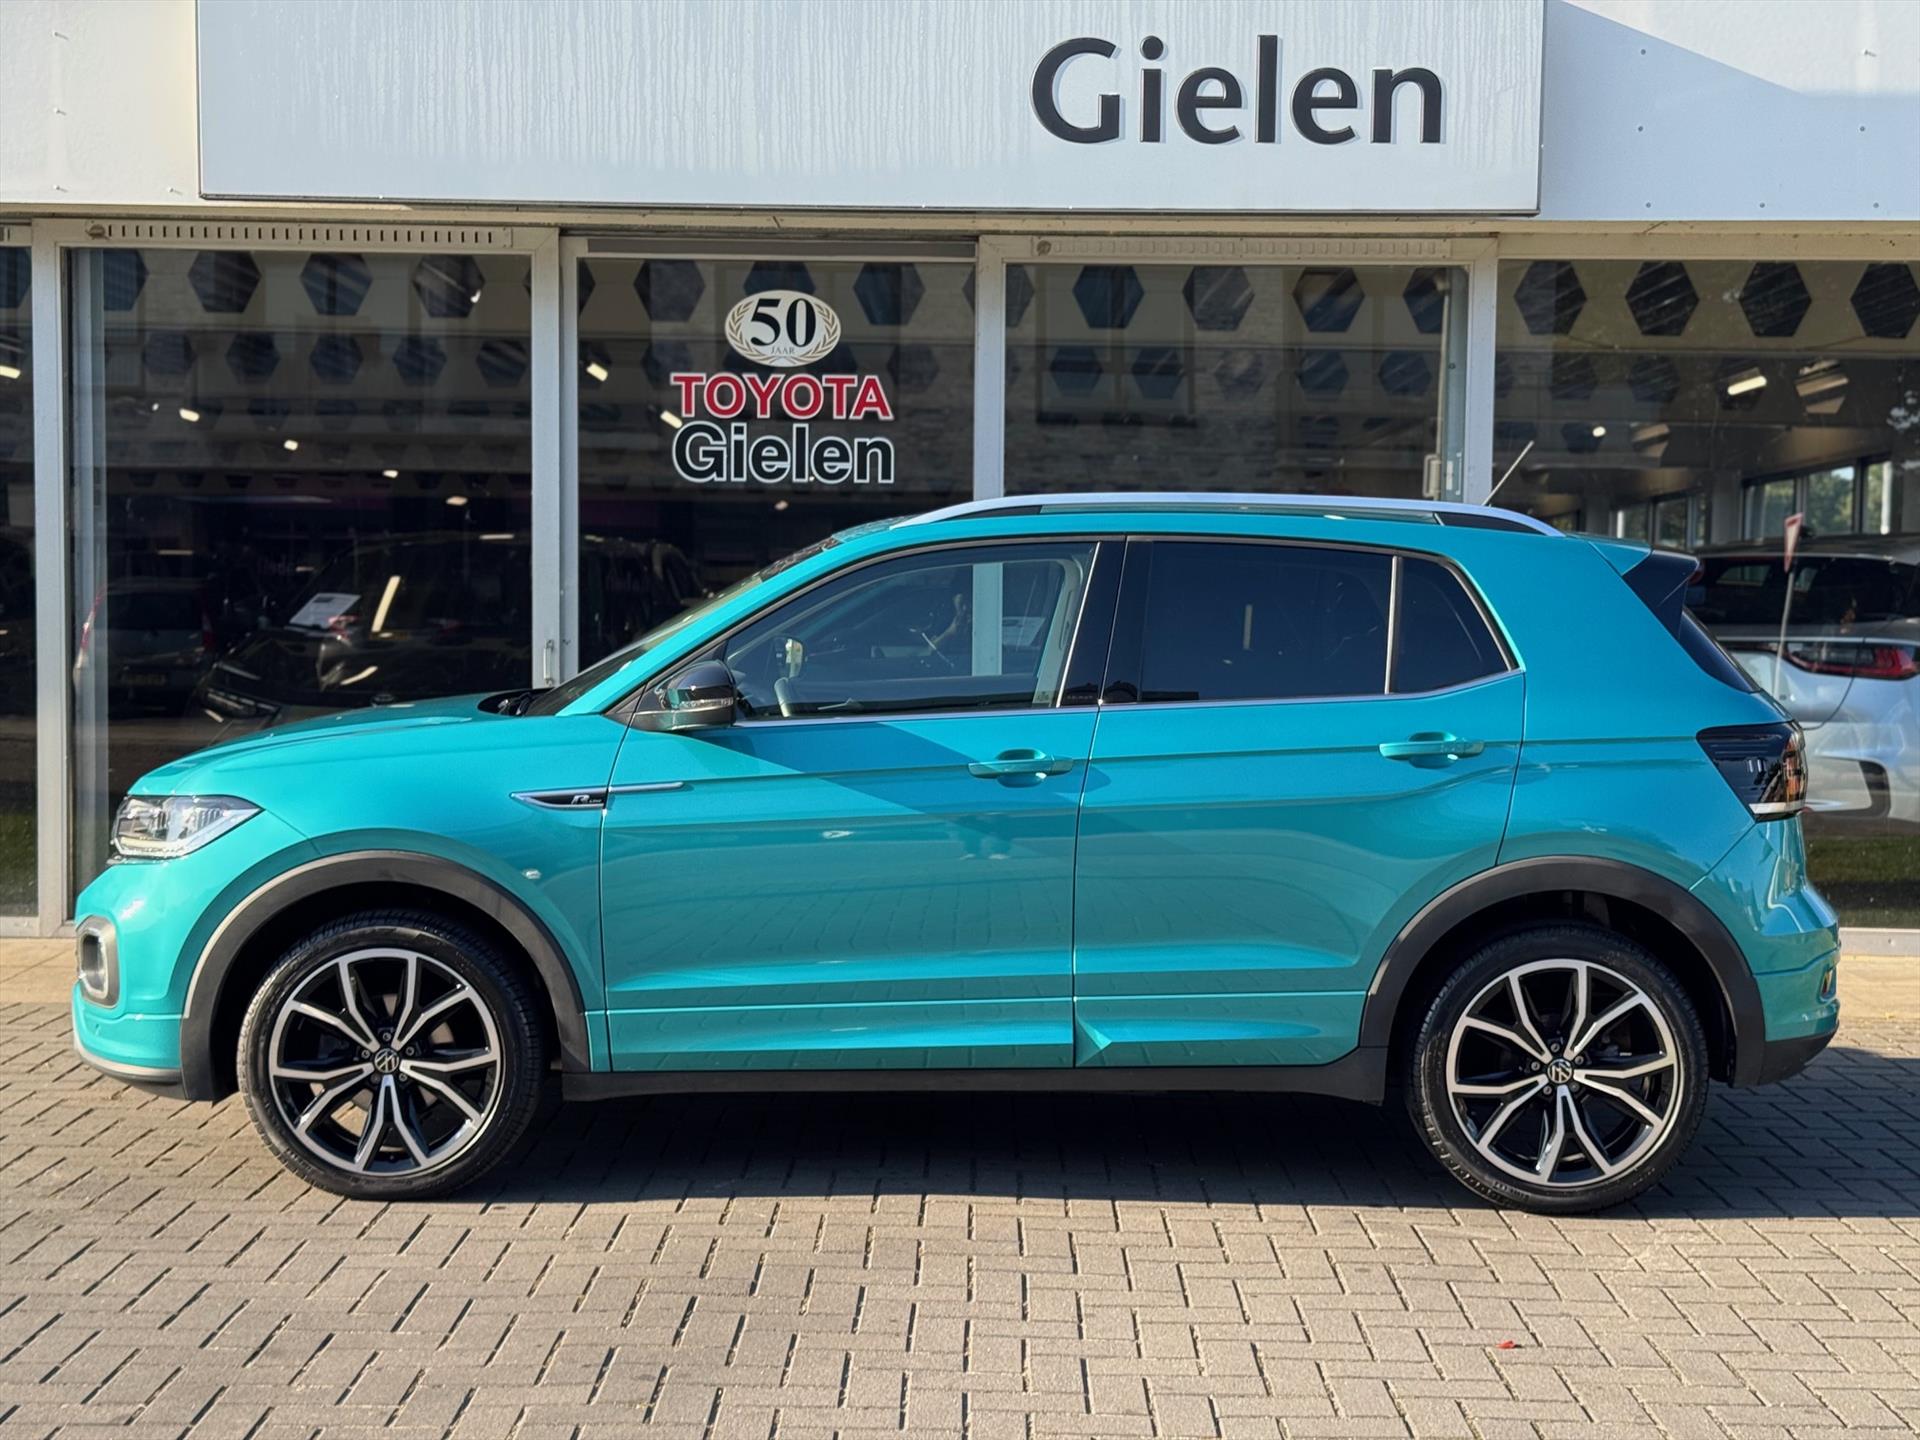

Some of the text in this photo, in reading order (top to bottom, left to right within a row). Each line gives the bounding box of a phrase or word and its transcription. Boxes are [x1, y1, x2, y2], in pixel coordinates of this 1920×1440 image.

[1030, 34, 1442, 144] Gielen
[751, 298, 816, 347] 50
[770, 346, 795, 354] JAAR
[670, 373, 894, 420] TOYOTA
[672, 421, 894, 484] Gielen
